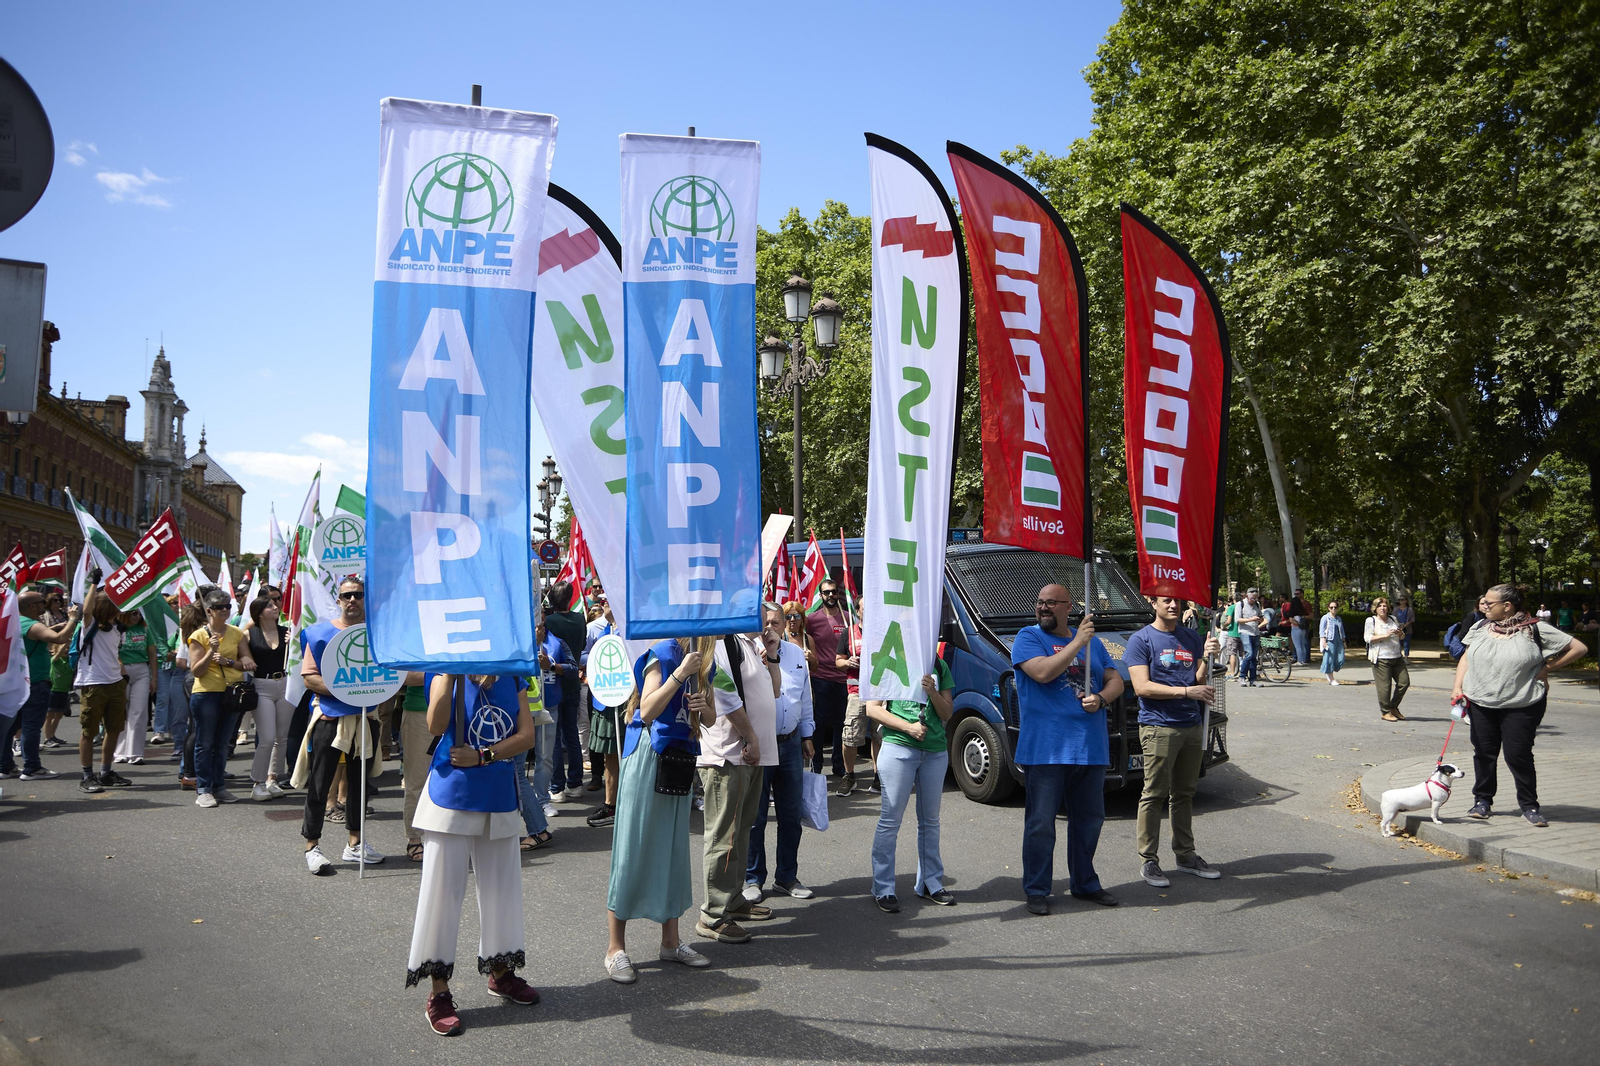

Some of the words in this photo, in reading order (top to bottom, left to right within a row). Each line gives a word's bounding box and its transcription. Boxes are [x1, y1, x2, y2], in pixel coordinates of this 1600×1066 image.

[388, 228, 515, 267] ANPE
[642, 236, 739, 268] ANPE
[387, 261, 435, 271] SINDICATO
[437, 265, 511, 276] INDEPENDIENTE
[642, 264, 681, 272] SINDICATO
[683, 265, 737, 275] INDEPENDIENTE
[659, 298, 723, 605] ANPE
[397, 307, 491, 655] ANPE
[321, 546, 366, 560] ANPE
[333, 665, 399, 684] ANPE
[593, 671, 631, 688] ANPE
